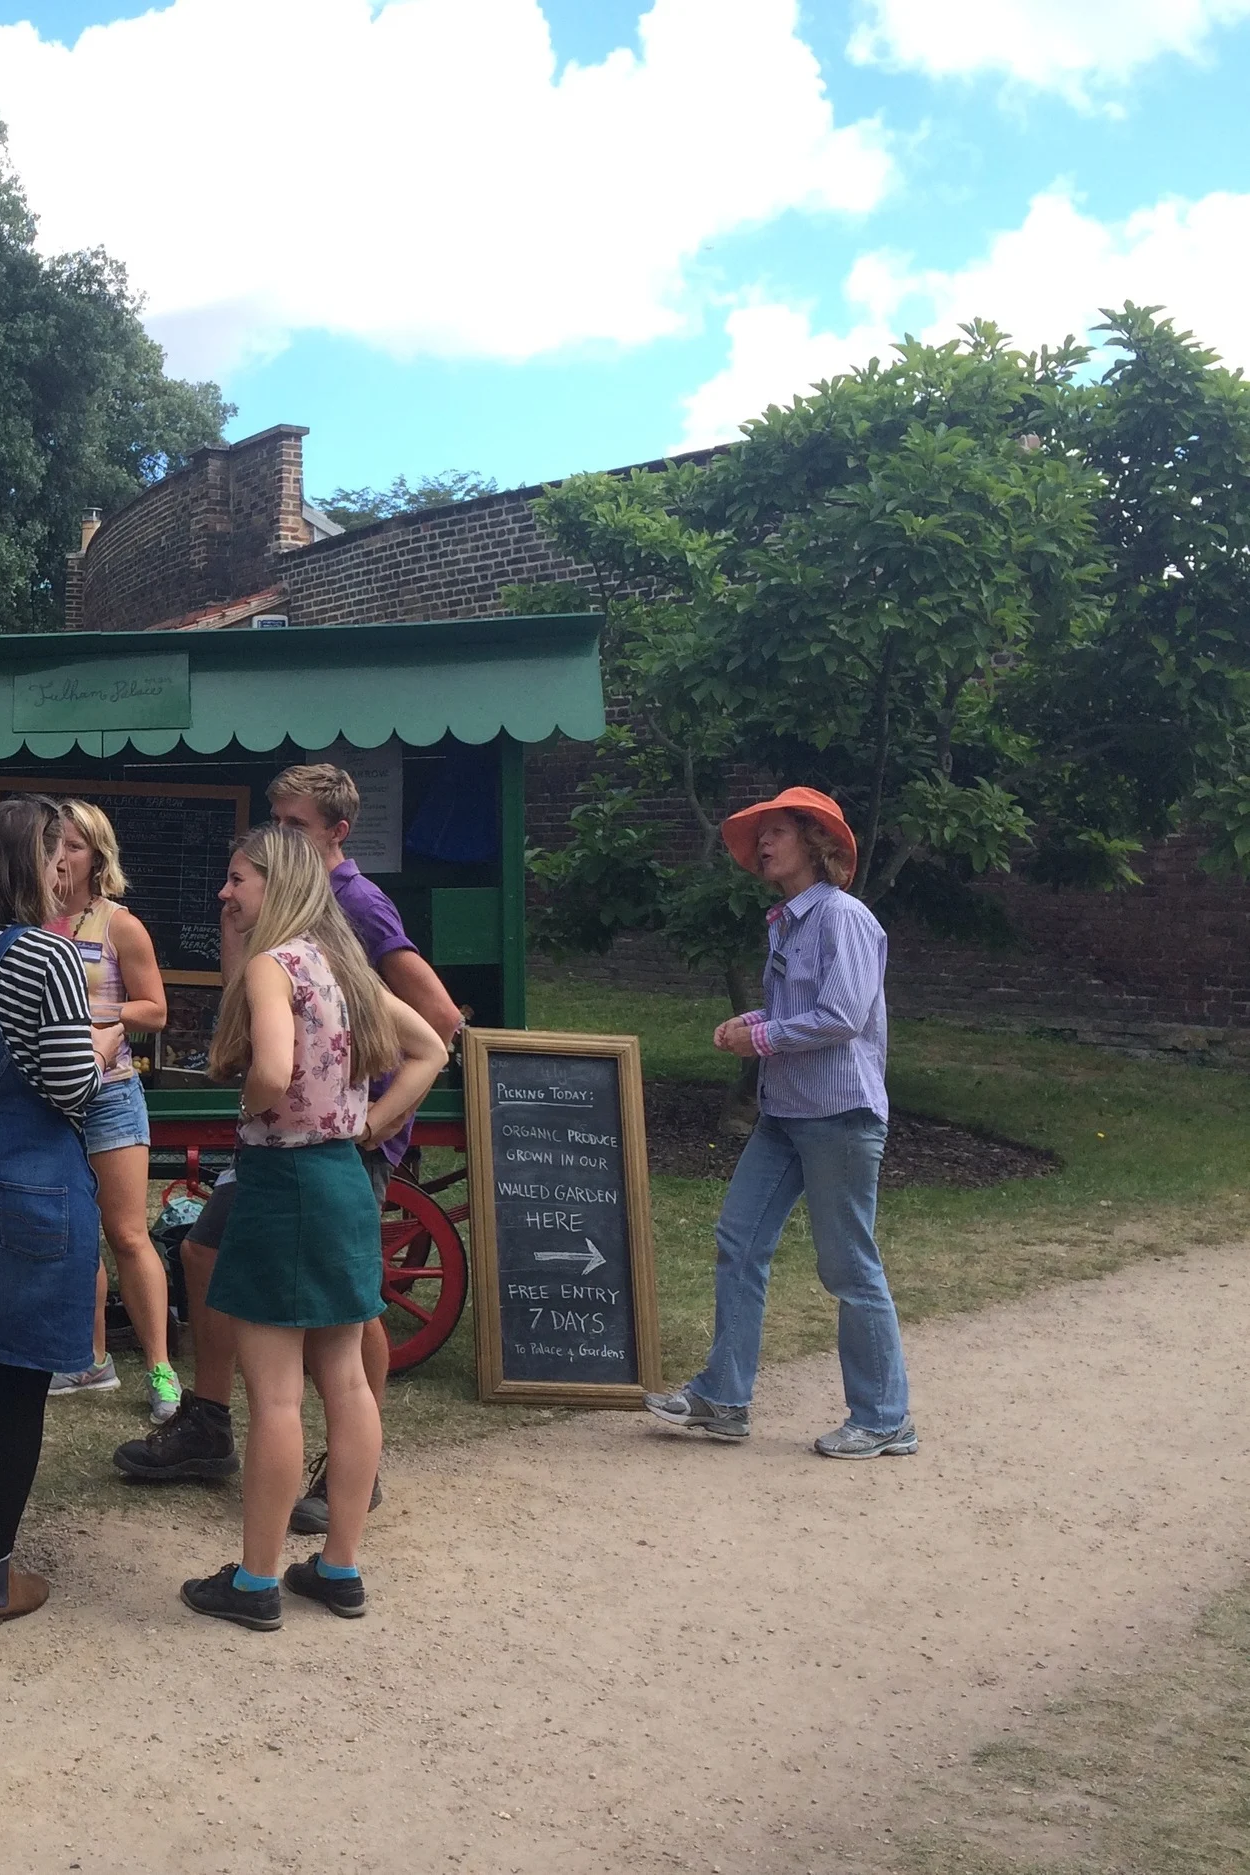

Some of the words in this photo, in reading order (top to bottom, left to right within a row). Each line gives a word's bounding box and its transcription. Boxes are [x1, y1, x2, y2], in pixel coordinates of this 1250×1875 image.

[28, 676, 108, 708] Fulham
[110, 680, 163, 703] Palace
[496, 1082, 546, 1100] PICKING
[549, 1087, 594, 1102] TODAY:
[502, 1124, 562, 1143] ORGANIC
[567, 1129, 618, 1148] PRODUCE
[506, 1149, 553, 1165] GROWN
[560, 1153, 574, 1167] IN
[579, 1155, 609, 1171] OUR
[497, 1181, 551, 1201] WALLED
[554, 1186, 618, 1204] GARDEN
[525, 1211, 585, 1232] HERE
[507, 1284, 550, 1300] FREE
[560, 1284, 620, 1306] ENTRY
[528, 1308, 544, 1329] 7
[550, 1310, 606, 1334] DAYS
[515, 1344, 526, 1356] To
[530, 1343, 563, 1357] Palace
[578, 1344, 626, 1361] Gardens
